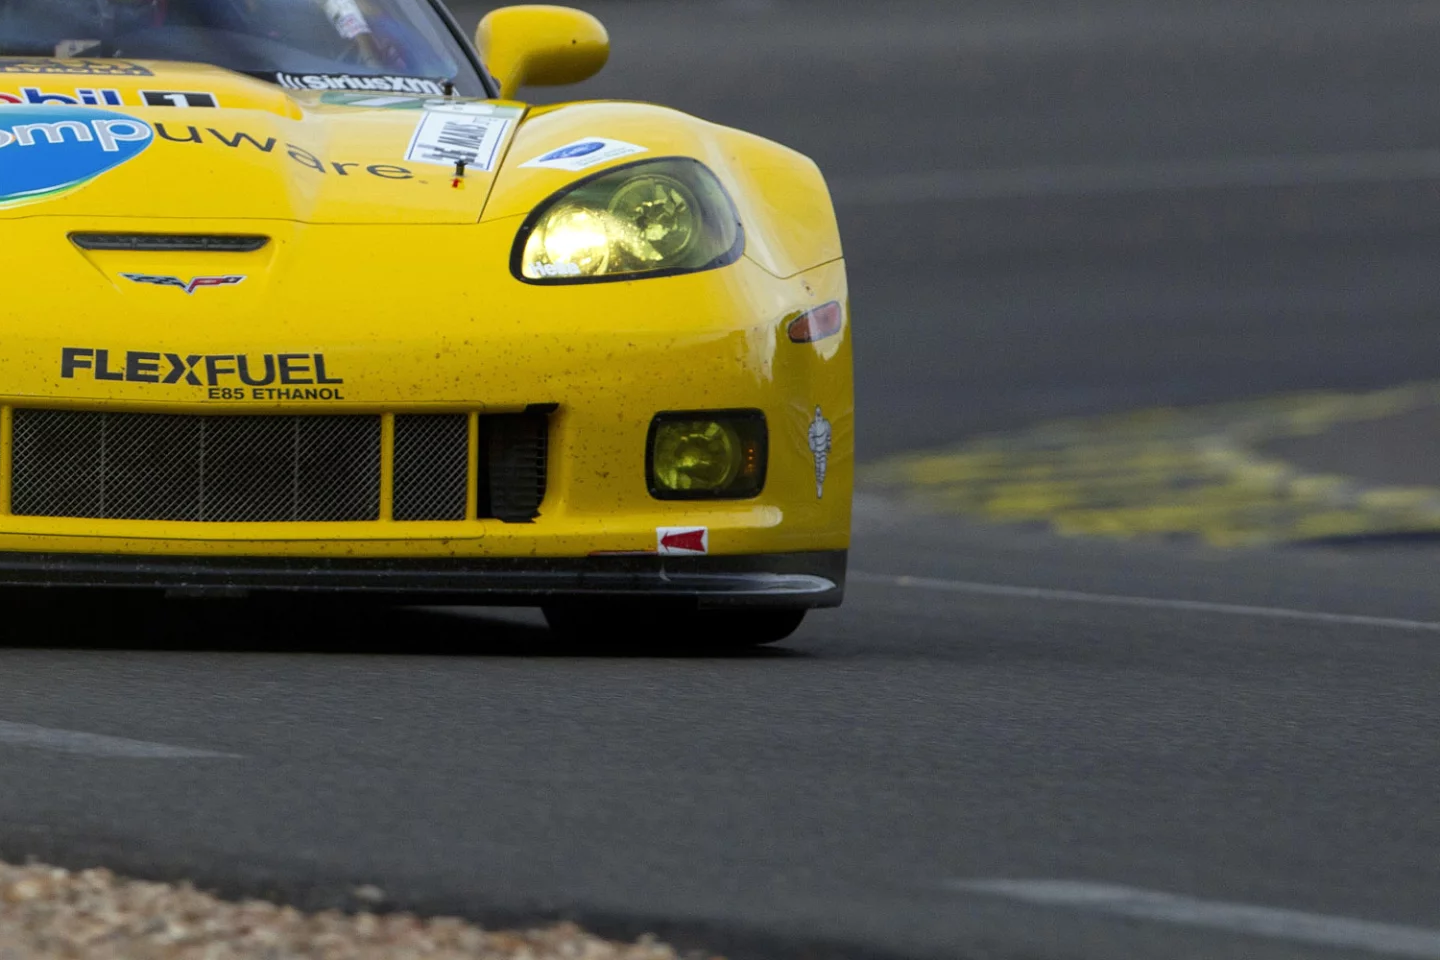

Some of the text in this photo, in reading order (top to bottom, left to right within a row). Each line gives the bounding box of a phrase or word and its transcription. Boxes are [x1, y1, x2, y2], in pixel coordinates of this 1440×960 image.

[60, 347, 344, 386] FLEXFUEL
[208, 388, 344, 401] E85 ETHANOL
